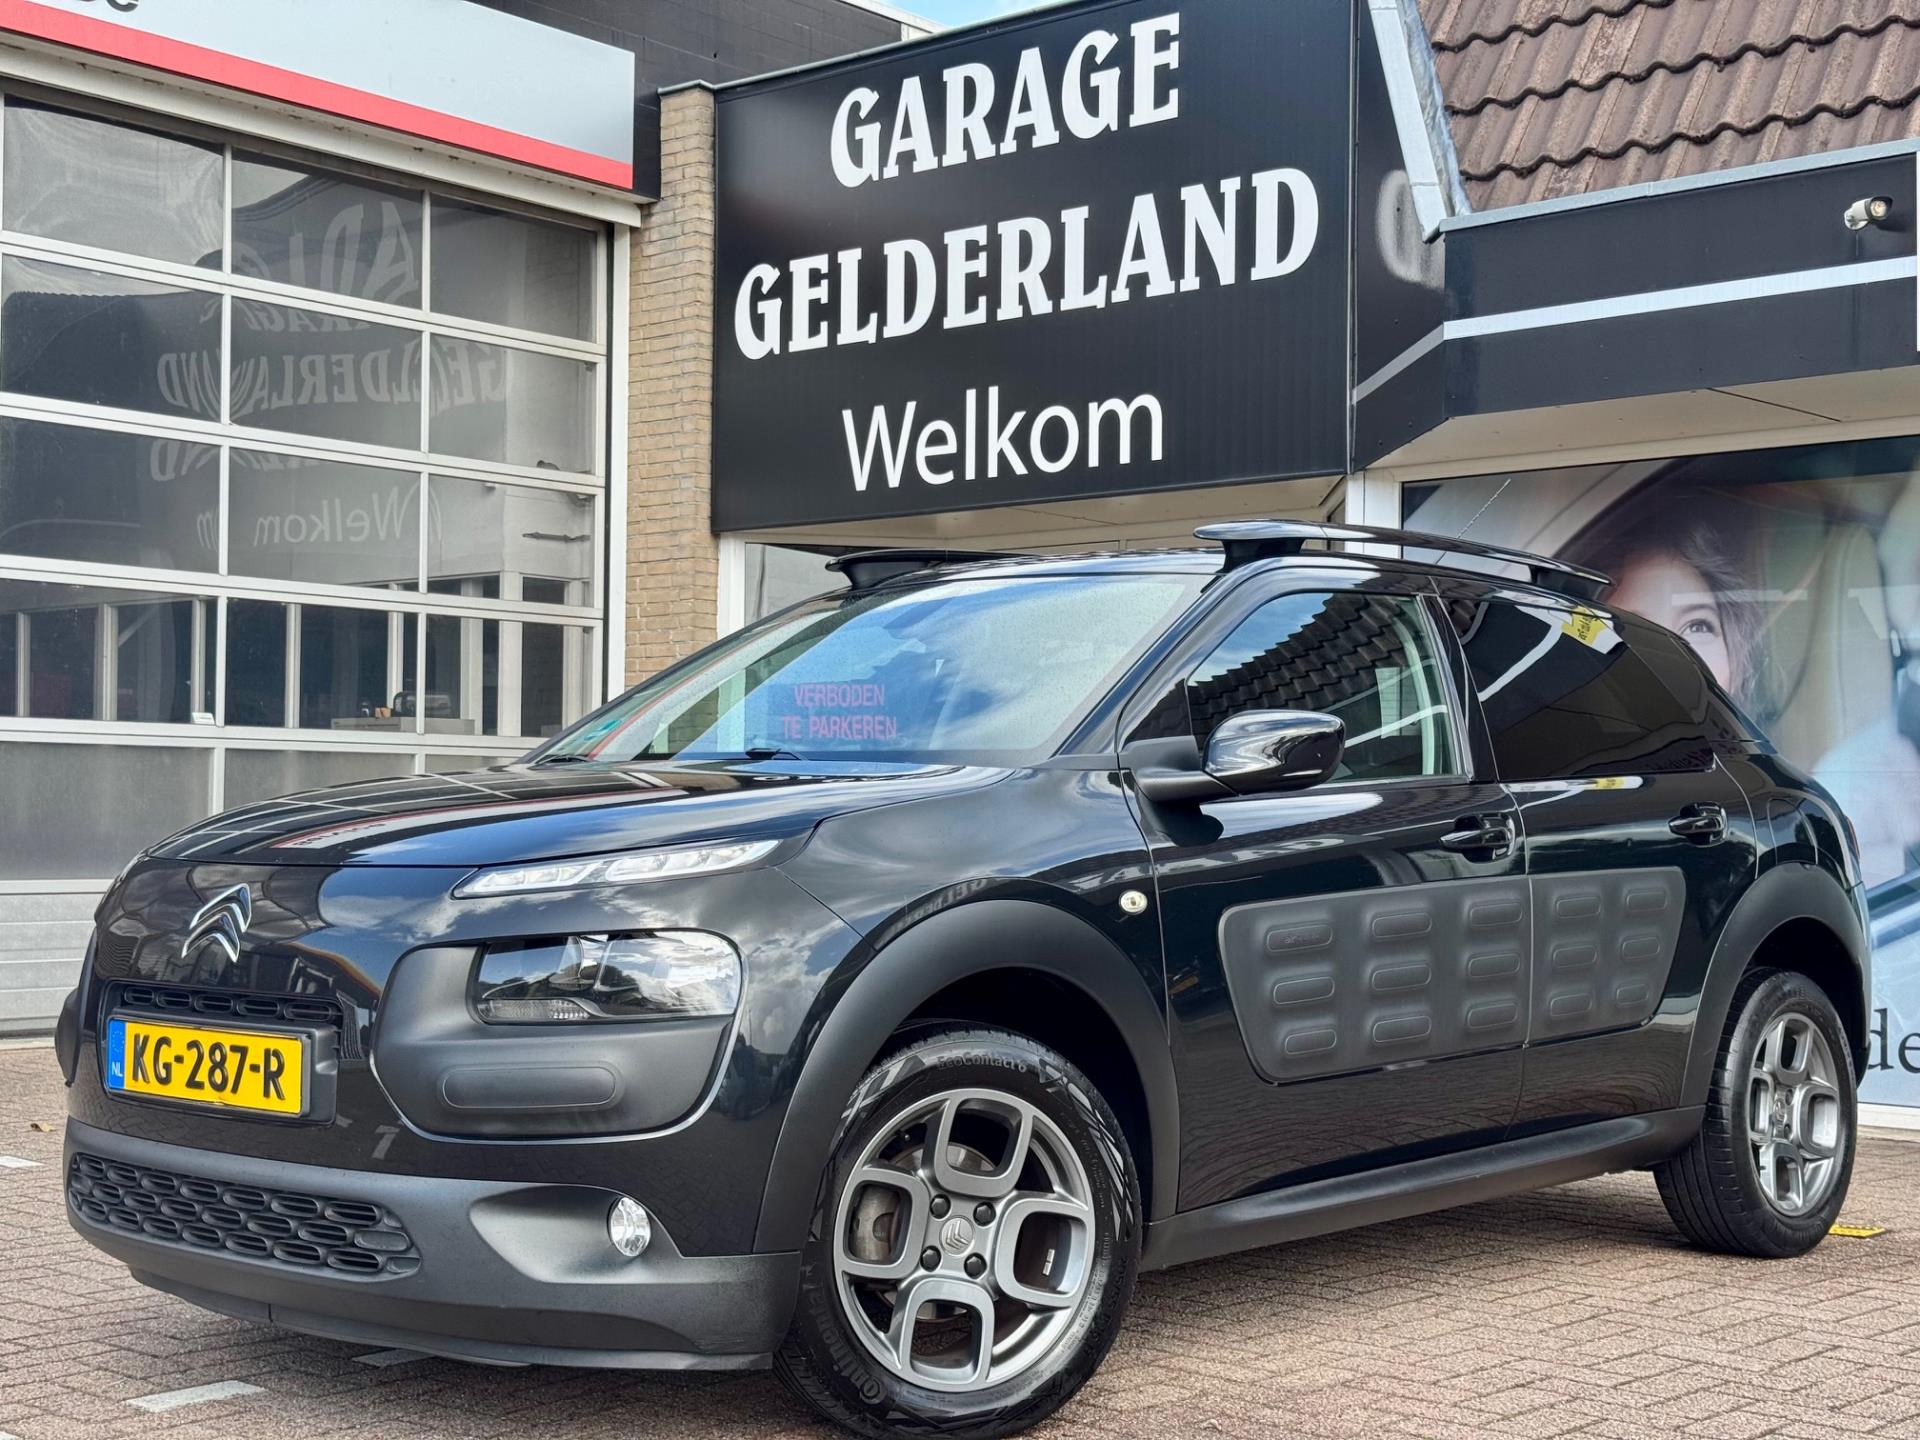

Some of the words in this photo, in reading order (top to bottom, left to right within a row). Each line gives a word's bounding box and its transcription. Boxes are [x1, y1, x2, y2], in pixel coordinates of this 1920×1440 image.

[830, 11, 1180, 189] GARAGE
[734, 167, 1319, 361] GELDERLAND
[841, 385, 1164, 492] Welkom
[783, 715, 801, 738] TE
[808, 715, 896, 738] PARKEREN
[793, 684, 885, 707] VERBODEN
[110, 1060, 124, 1078] NL
[131, 1032, 286, 1101] KG-287-R
